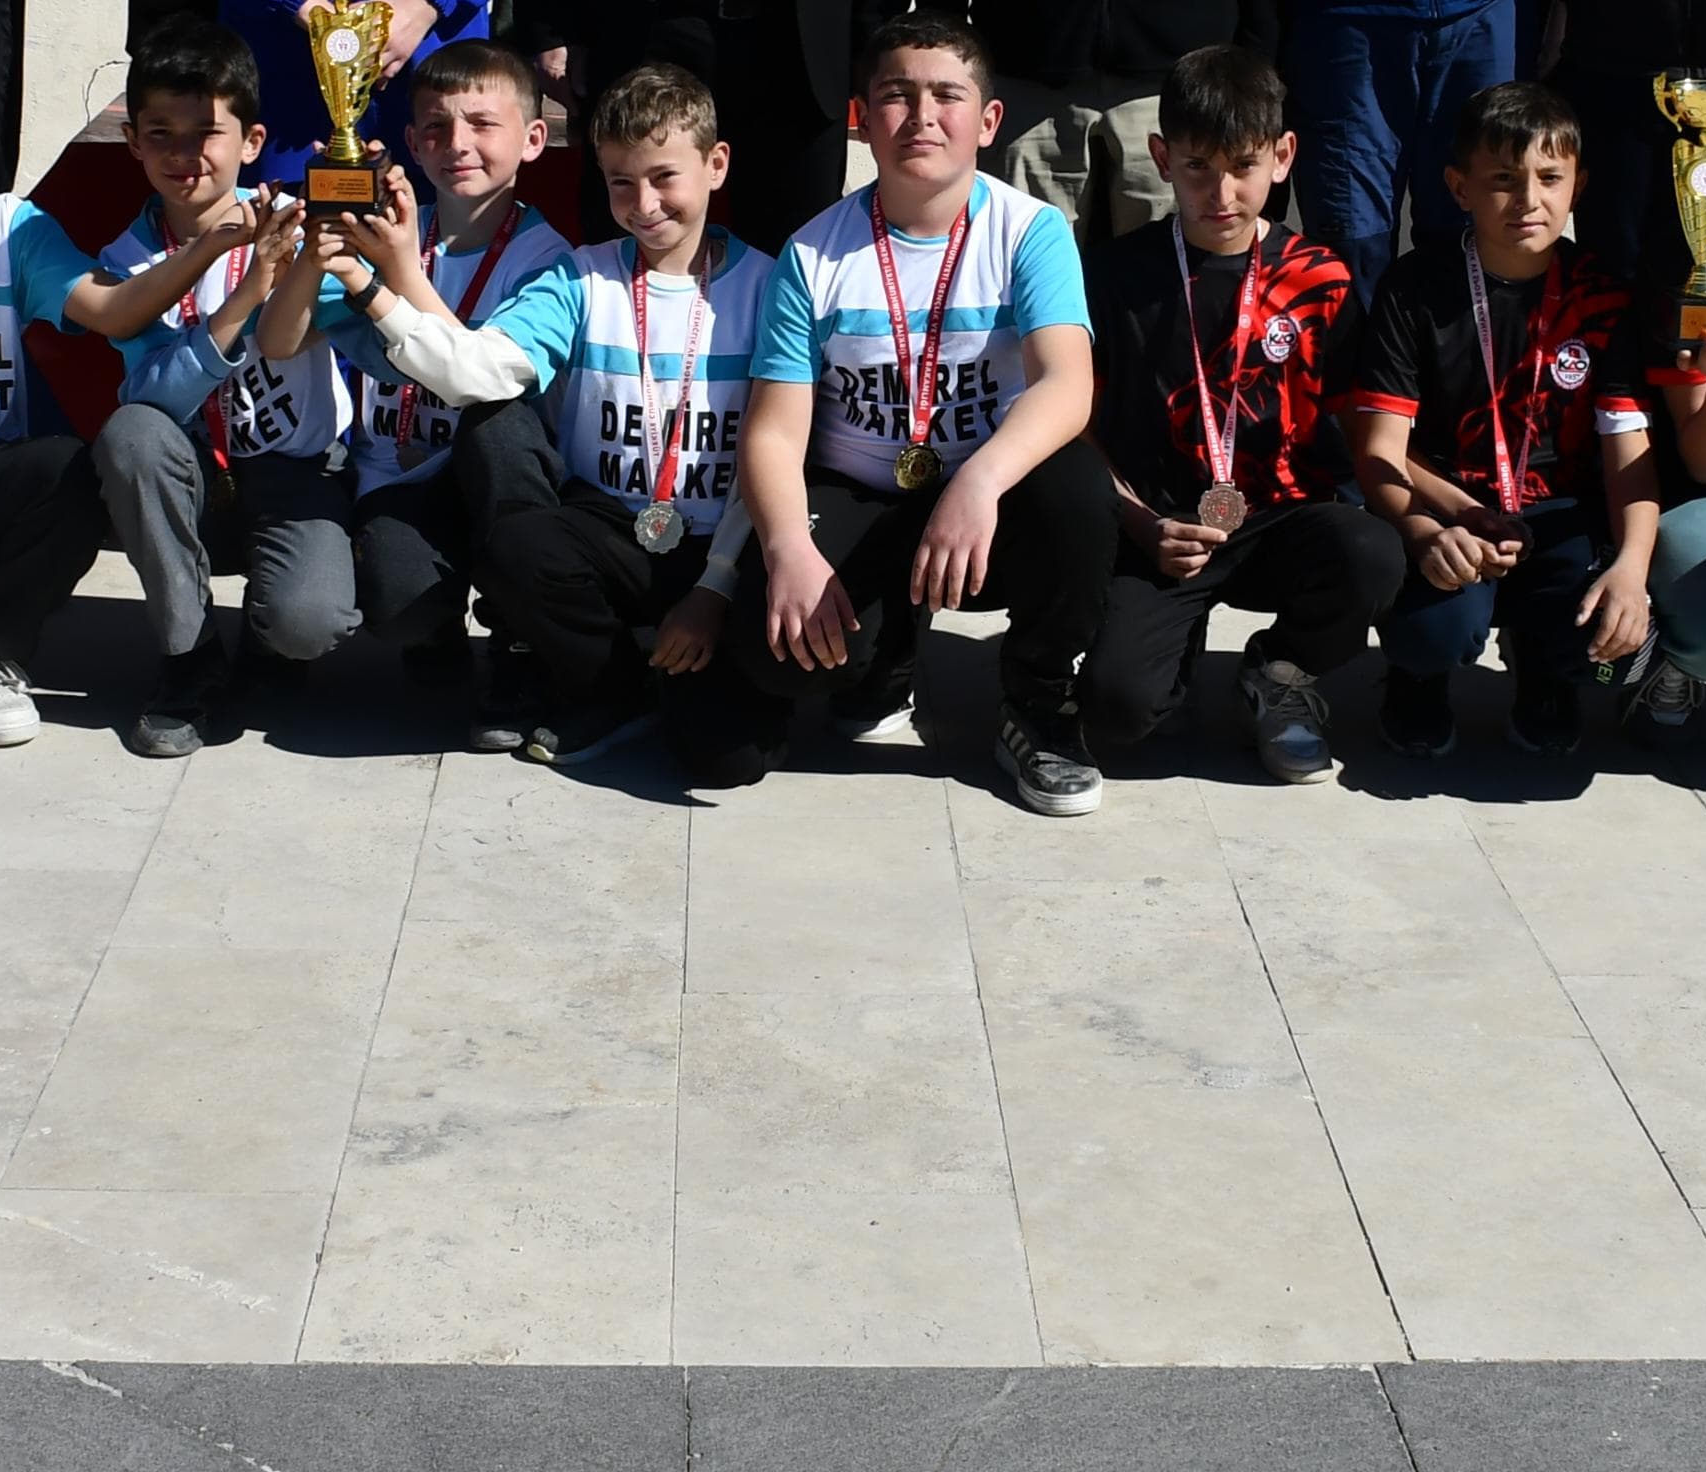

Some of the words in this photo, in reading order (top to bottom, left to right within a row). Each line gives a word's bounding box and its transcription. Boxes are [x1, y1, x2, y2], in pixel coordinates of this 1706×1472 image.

[835, 356, 999, 406] DEMİREL
[919, 360, 935, 410] BAKANLIĞI
[600, 400, 741, 454] DEMİRE
[844, 395, 999, 444] MARKET
[598, 450, 738, 499] MAKE
